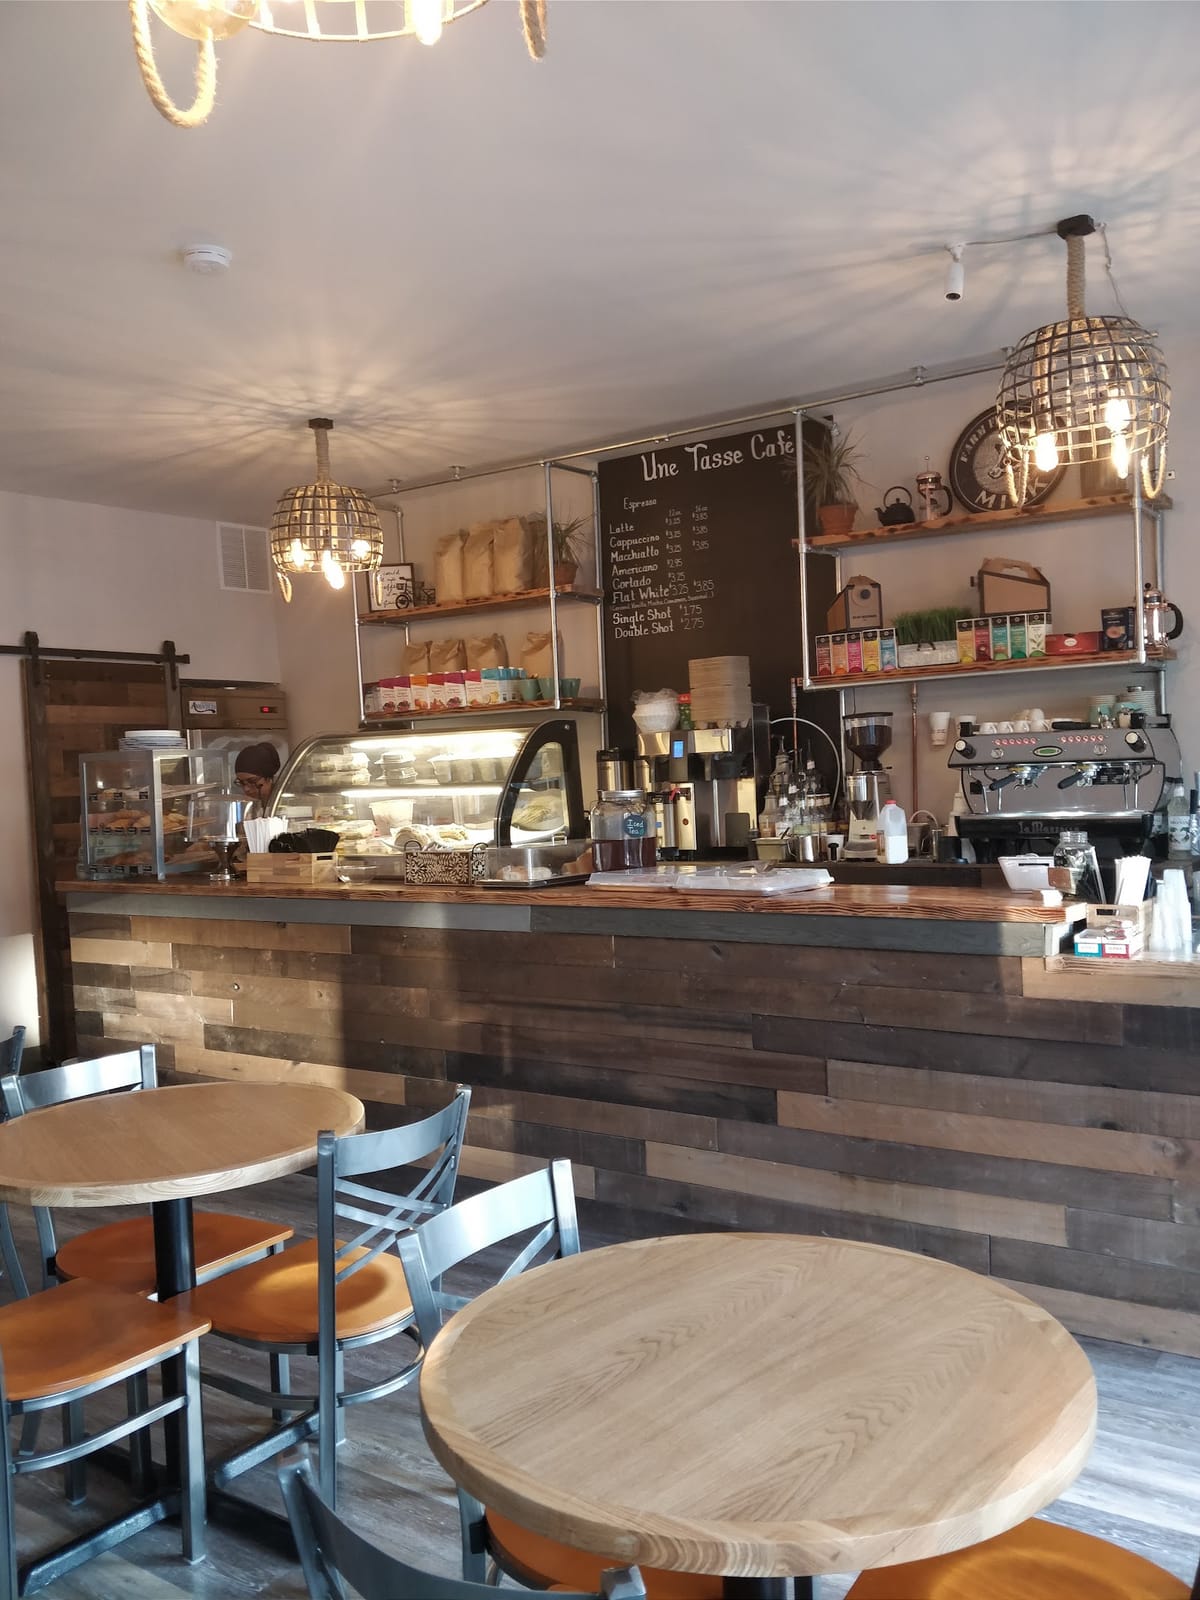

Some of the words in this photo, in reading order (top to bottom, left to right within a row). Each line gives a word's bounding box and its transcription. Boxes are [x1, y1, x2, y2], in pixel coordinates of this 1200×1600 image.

[959, 426, 987, 464] FARM
[640, 452, 679, 482] Une
[684, 443, 744, 472] Tasse
[750, 429, 795, 460] Café
[974, 474, 1048, 509] MIK
[624, 497, 657, 513] Espresso
[610, 522, 635, 535] Latte
[610, 534, 660, 550] Cappuccino
[612, 563, 658, 577] Americano
[613, 575, 652, 590] Cortado
[613, 586, 635, 604] Flat
[639, 584, 670, 600] White
[613, 610, 645, 629] Single
[648, 606, 672, 621] Shot
[615, 624, 649, 640] Double
[652, 619, 675, 634] Shot
[627, 818, 644, 828] Iced
[627, 826, 640, 835] Tea
